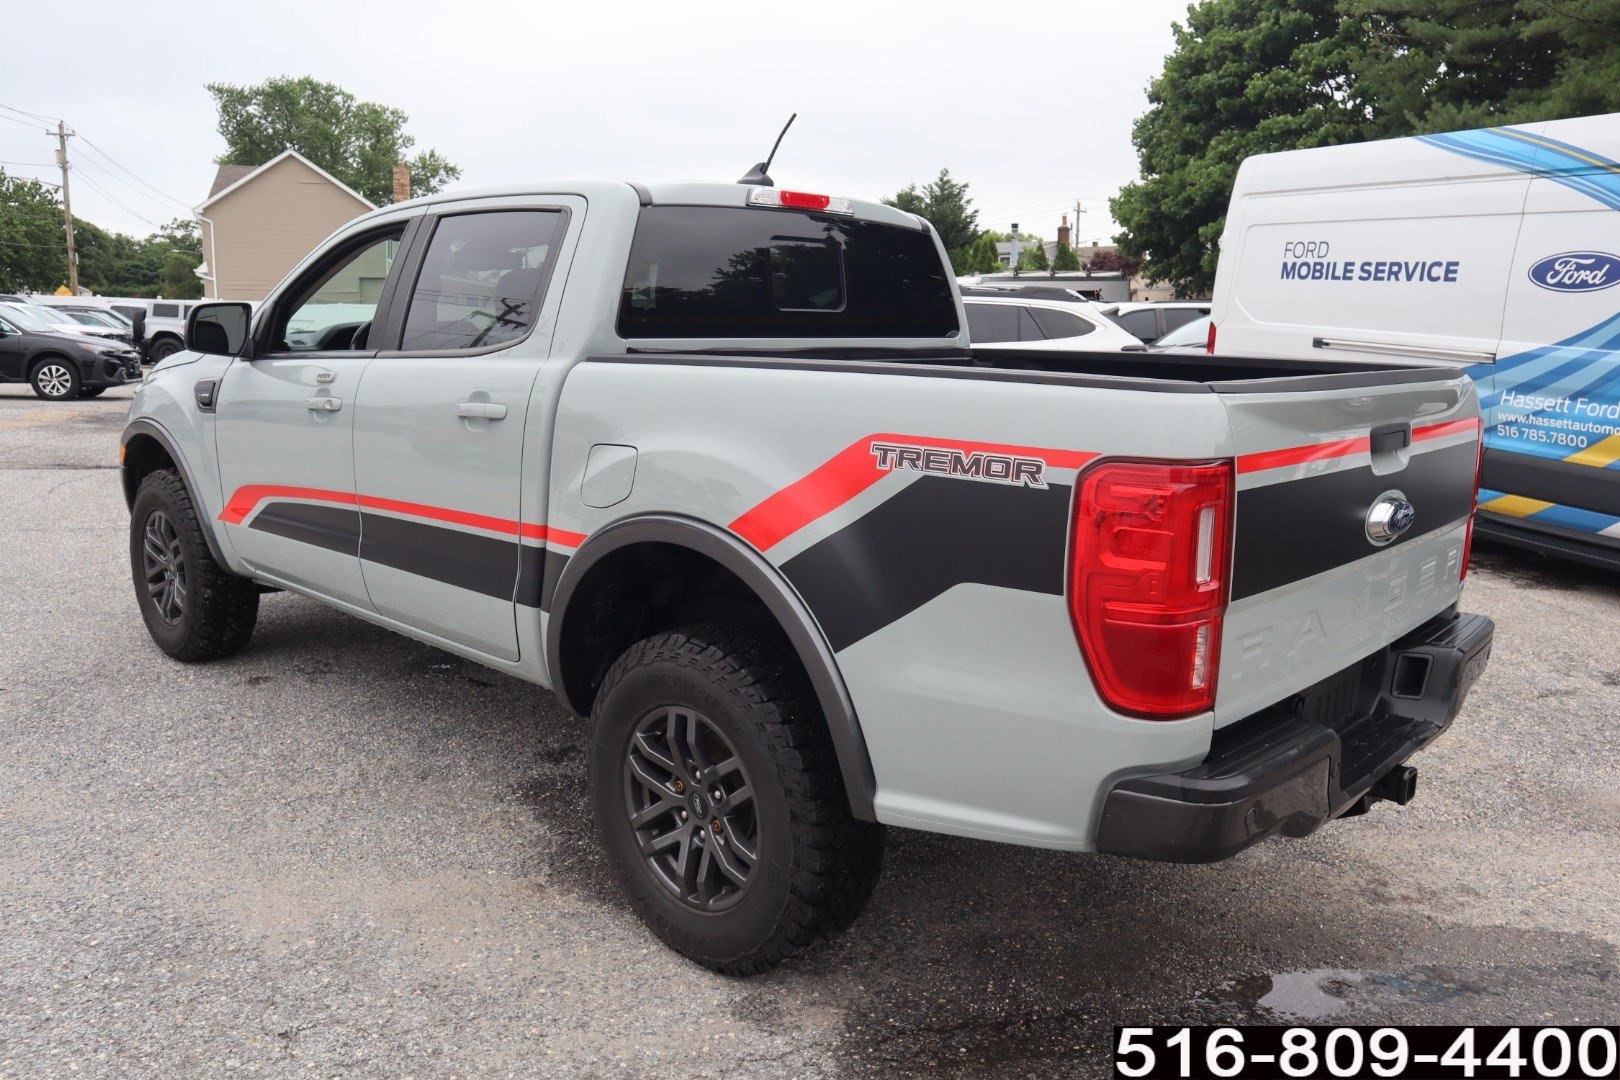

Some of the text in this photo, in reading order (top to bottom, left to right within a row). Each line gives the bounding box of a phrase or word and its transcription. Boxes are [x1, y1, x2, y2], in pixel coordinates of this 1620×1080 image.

[1284, 241, 1329, 259] FORD
[1280, 261, 1460, 282] MOBILE SERVICE
[1546, 257, 1611, 285] Ford
[1500, 389, 1620, 419] Hassett Ford
[1497, 424, 1588, 448] 516 785.7800
[871, 442, 1047, 488] TREMOR
